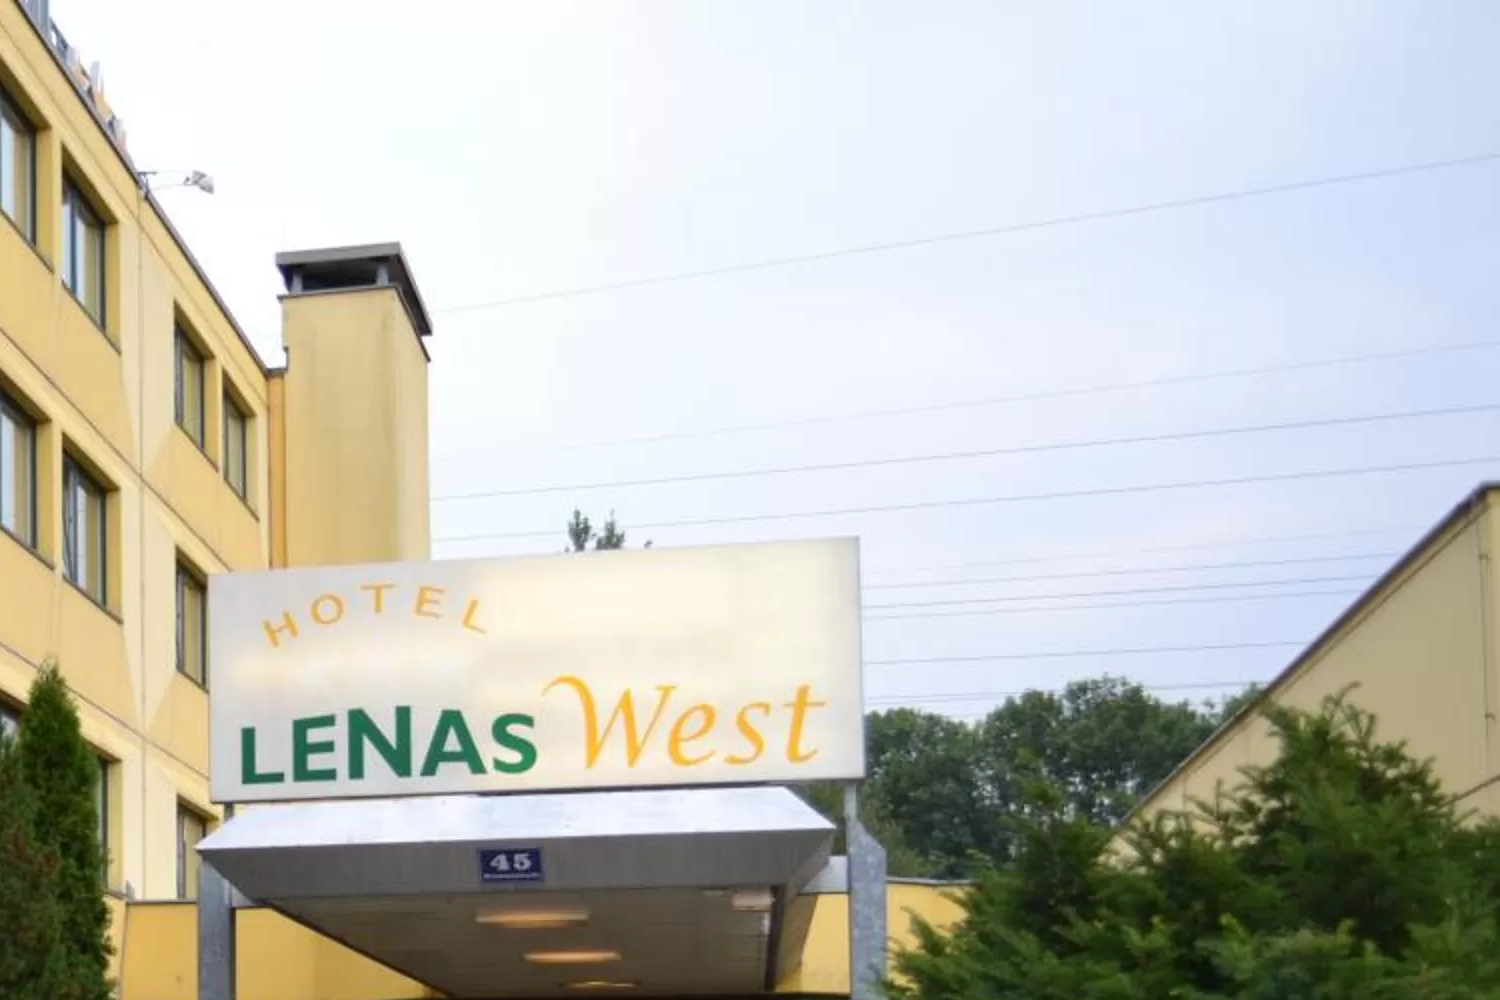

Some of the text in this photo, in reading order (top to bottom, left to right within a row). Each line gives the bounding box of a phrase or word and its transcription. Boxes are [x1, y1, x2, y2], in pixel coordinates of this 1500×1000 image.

[262, 582, 489, 648] HOTEL
[240, 674, 827, 785] LENAS West
[489, 853, 532, 871] 45
